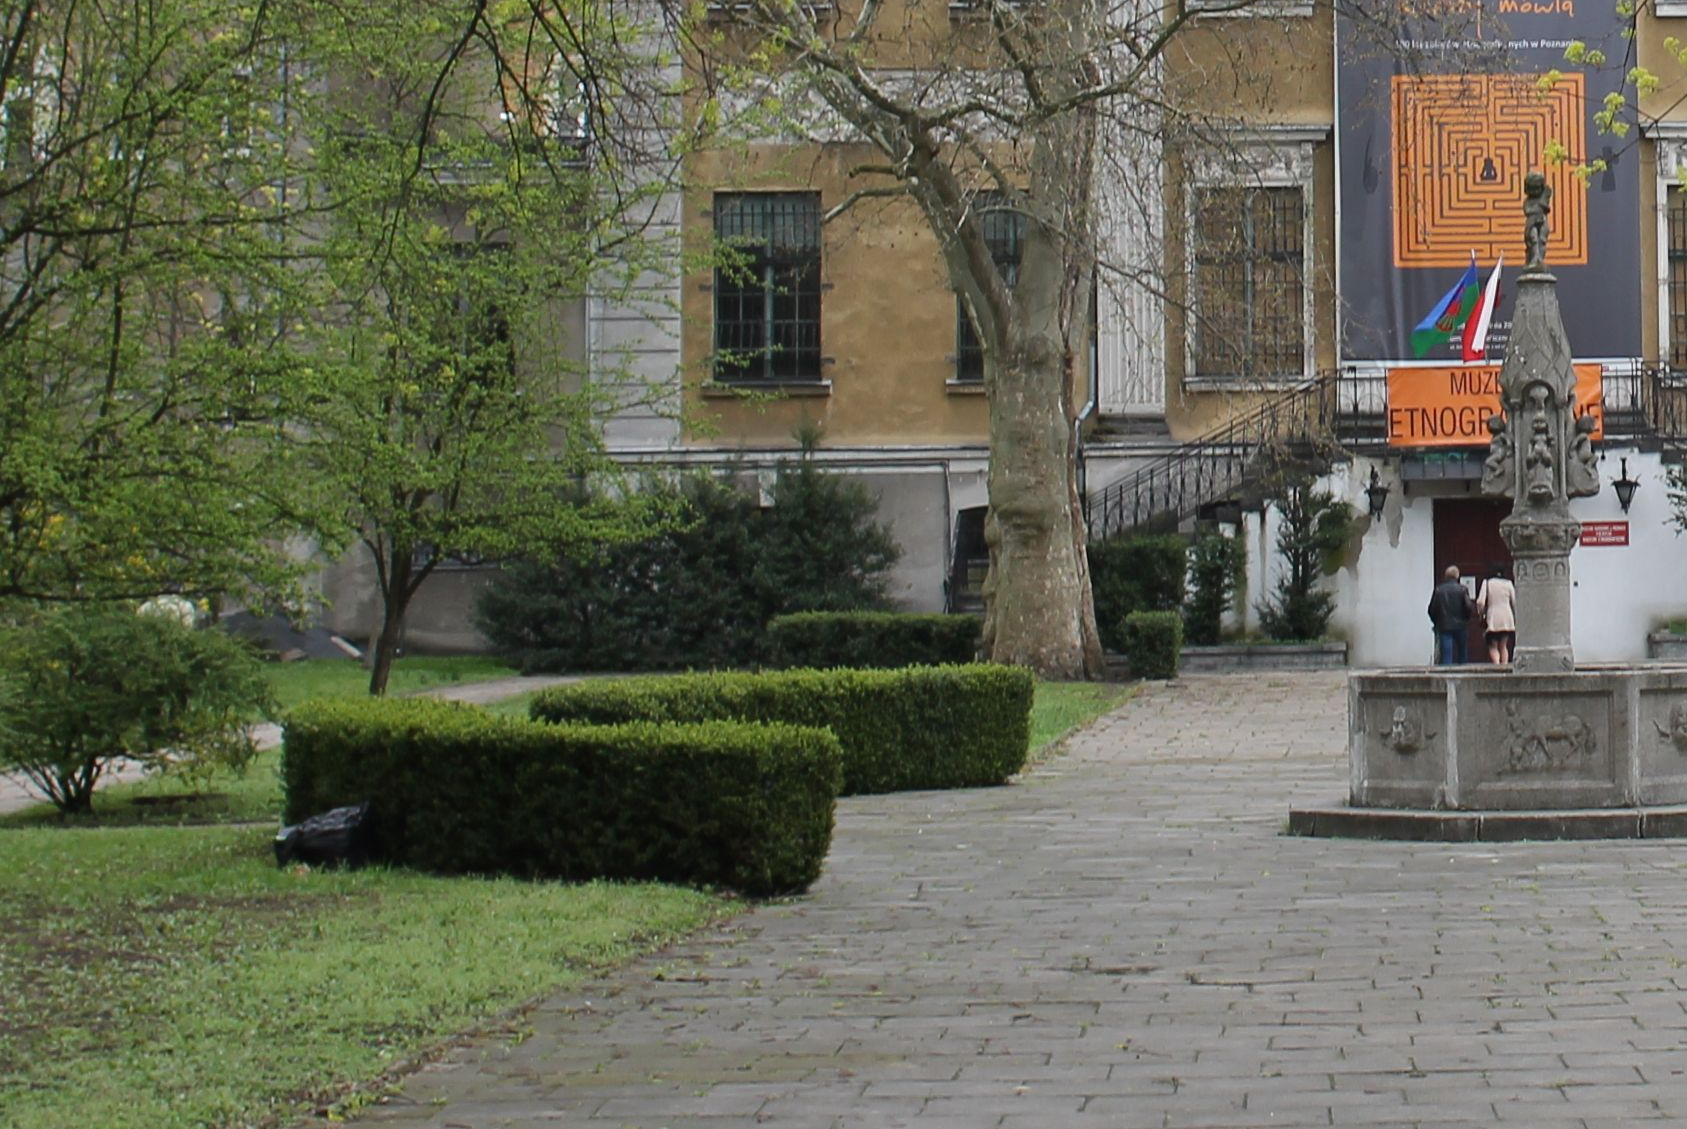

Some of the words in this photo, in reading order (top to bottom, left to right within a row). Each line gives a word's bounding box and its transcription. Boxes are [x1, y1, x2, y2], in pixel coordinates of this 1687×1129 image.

[1530, 40, 1539, 48] w
[1540, 38, 1578, 49] Poznani
[1449, 371, 1503, 396] MUZE
